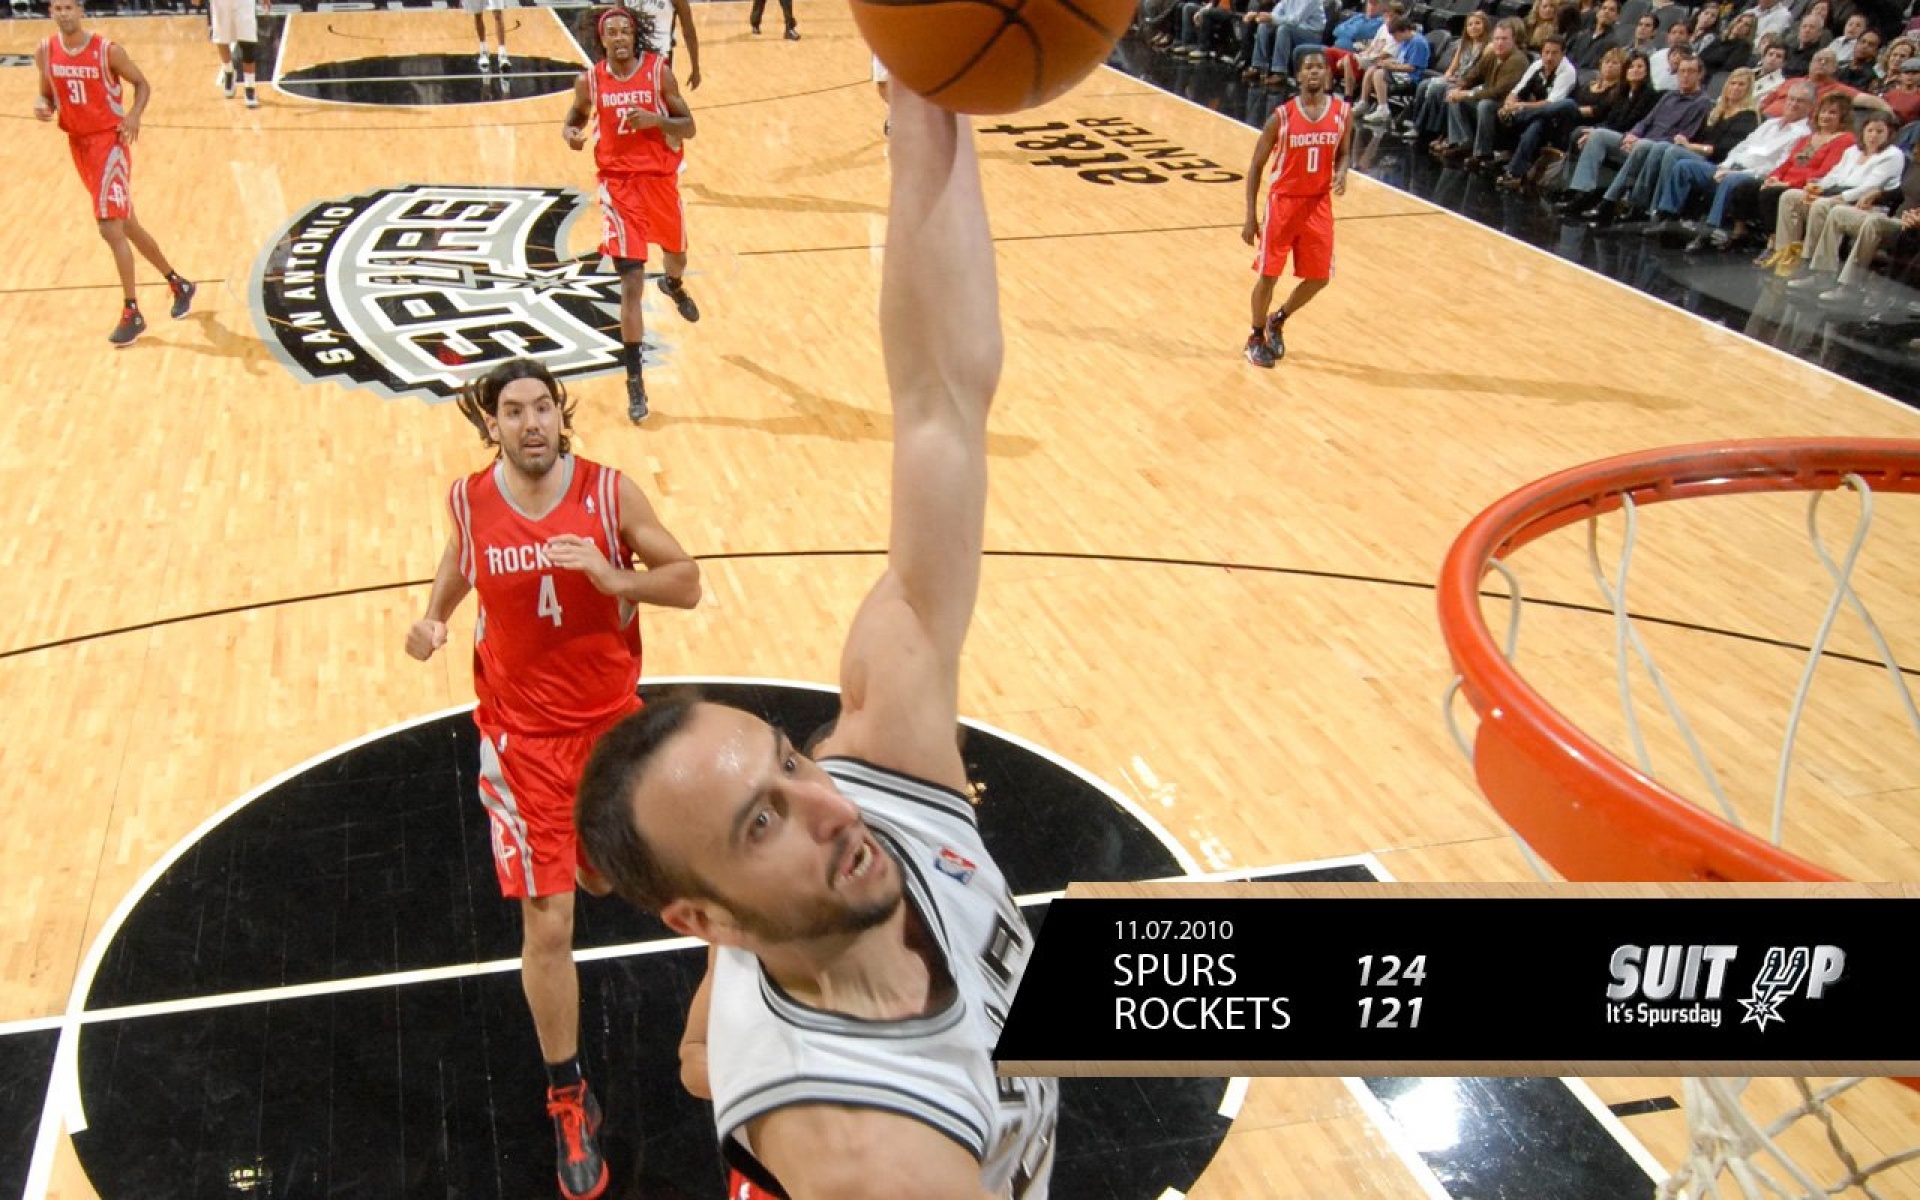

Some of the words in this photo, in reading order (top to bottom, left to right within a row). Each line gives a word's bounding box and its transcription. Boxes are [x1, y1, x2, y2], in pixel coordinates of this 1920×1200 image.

[51, 64, 99, 79] ROCKETS
[67, 80, 87, 105] 31
[601, 90, 652, 107] ROCKETS
[1076, 116, 1244, 184] CENTER
[1289, 131, 1339, 148] ROCKETS
[1307, 147, 1319, 173] 0
[283, 205, 355, 301] ANTONIO
[357, 198, 576, 369] SPURS
[288, 311, 355, 365] SAN
[485, 536, 596, 576] ROCK
[537, 574, 563, 627] 4
